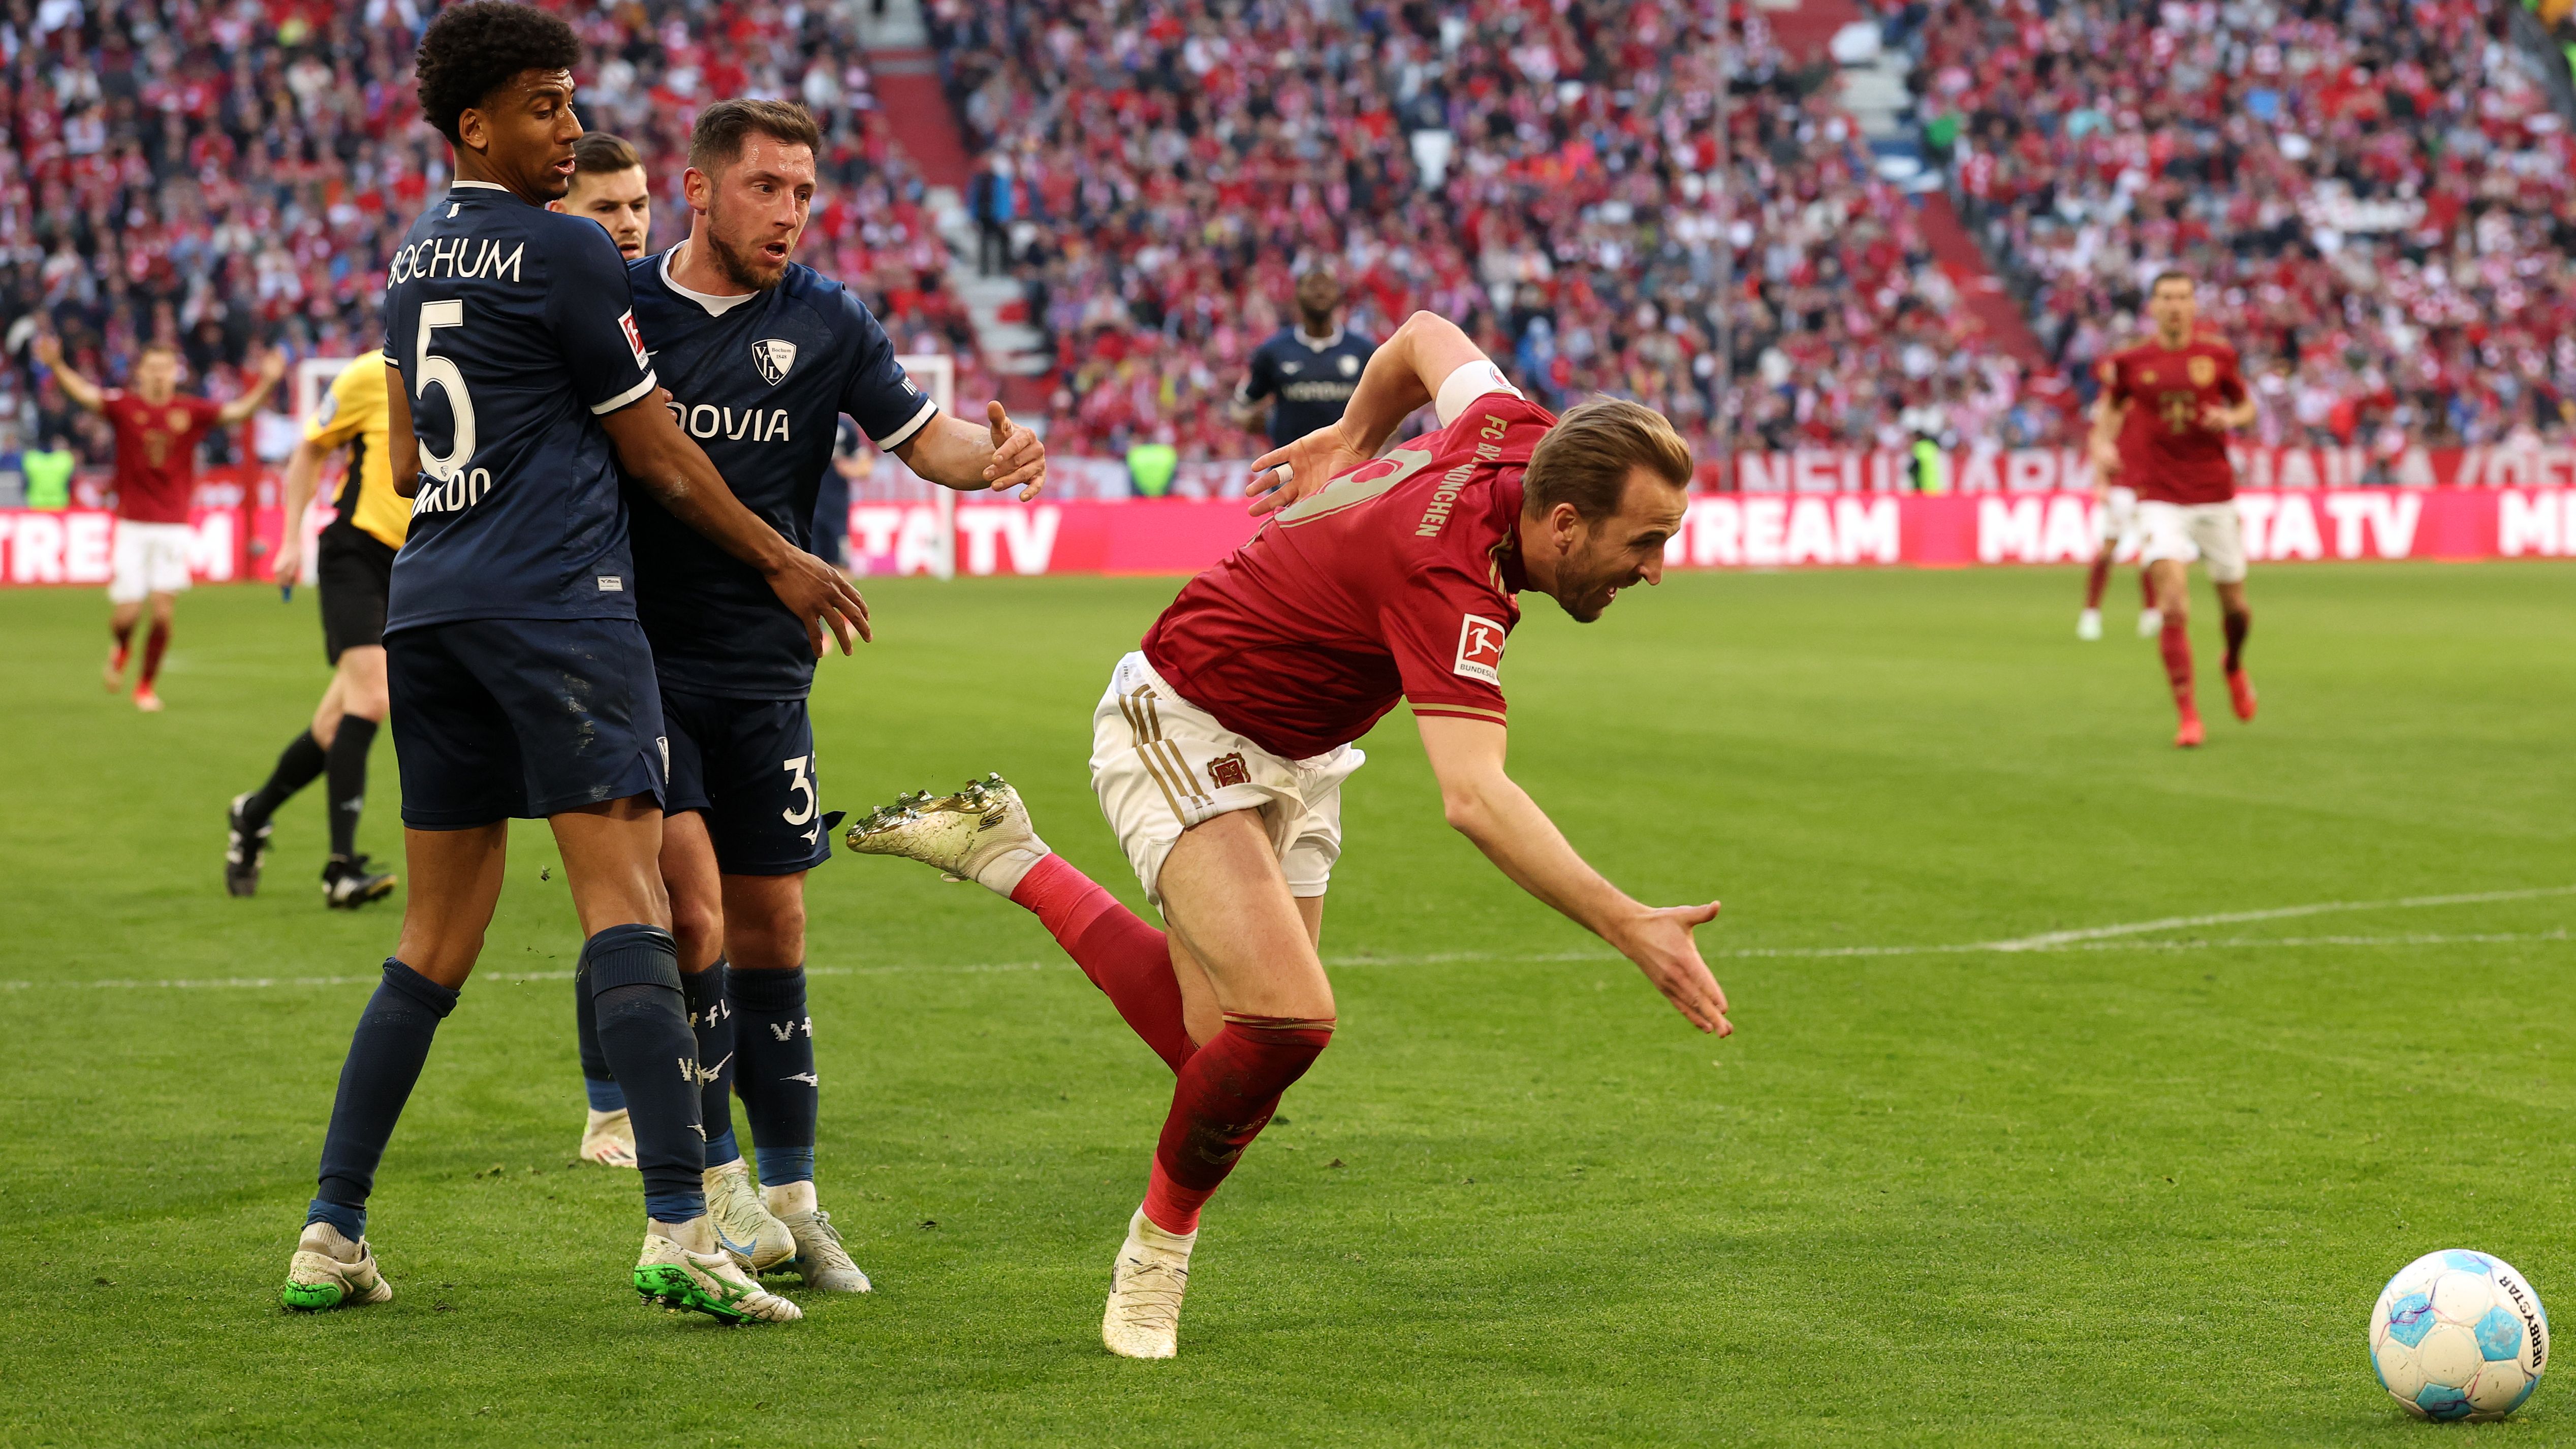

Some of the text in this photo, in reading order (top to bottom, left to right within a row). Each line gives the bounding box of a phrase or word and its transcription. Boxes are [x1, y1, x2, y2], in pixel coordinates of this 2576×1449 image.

[388, 238, 524, 290] BOCHUM
[416, 299, 476, 482] 5
[1481, 414, 1507, 439] FC
[956, 507, 1062, 576] TV
[1663, 495, 1899, 565] TREAM
[2325, 493, 2423, 560] TV
[782, 750, 819, 826] 3
[2498, 1275, 2542, 1368] DERBYSTAR
